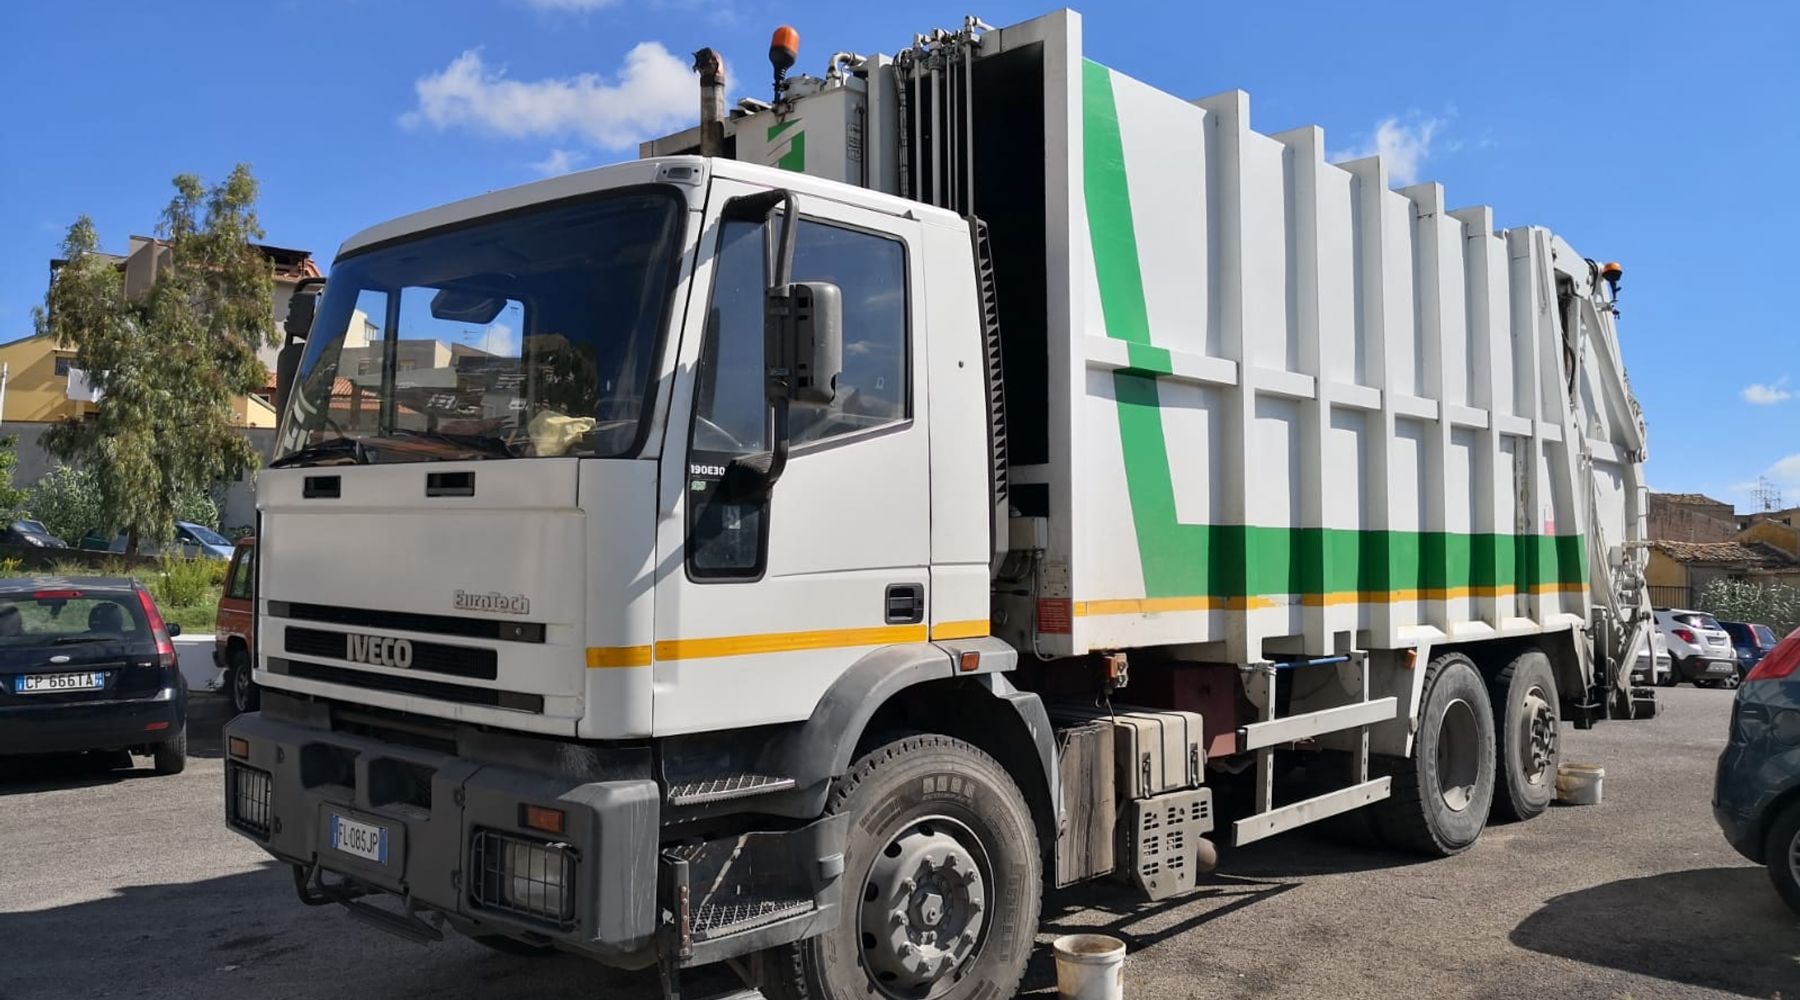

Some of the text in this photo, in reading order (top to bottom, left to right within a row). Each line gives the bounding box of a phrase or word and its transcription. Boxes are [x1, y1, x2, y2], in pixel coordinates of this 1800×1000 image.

[690, 464, 726, 476] 190E30
[453, 589, 530, 615] EuroTech
[346, 632, 414, 669] IVECO
